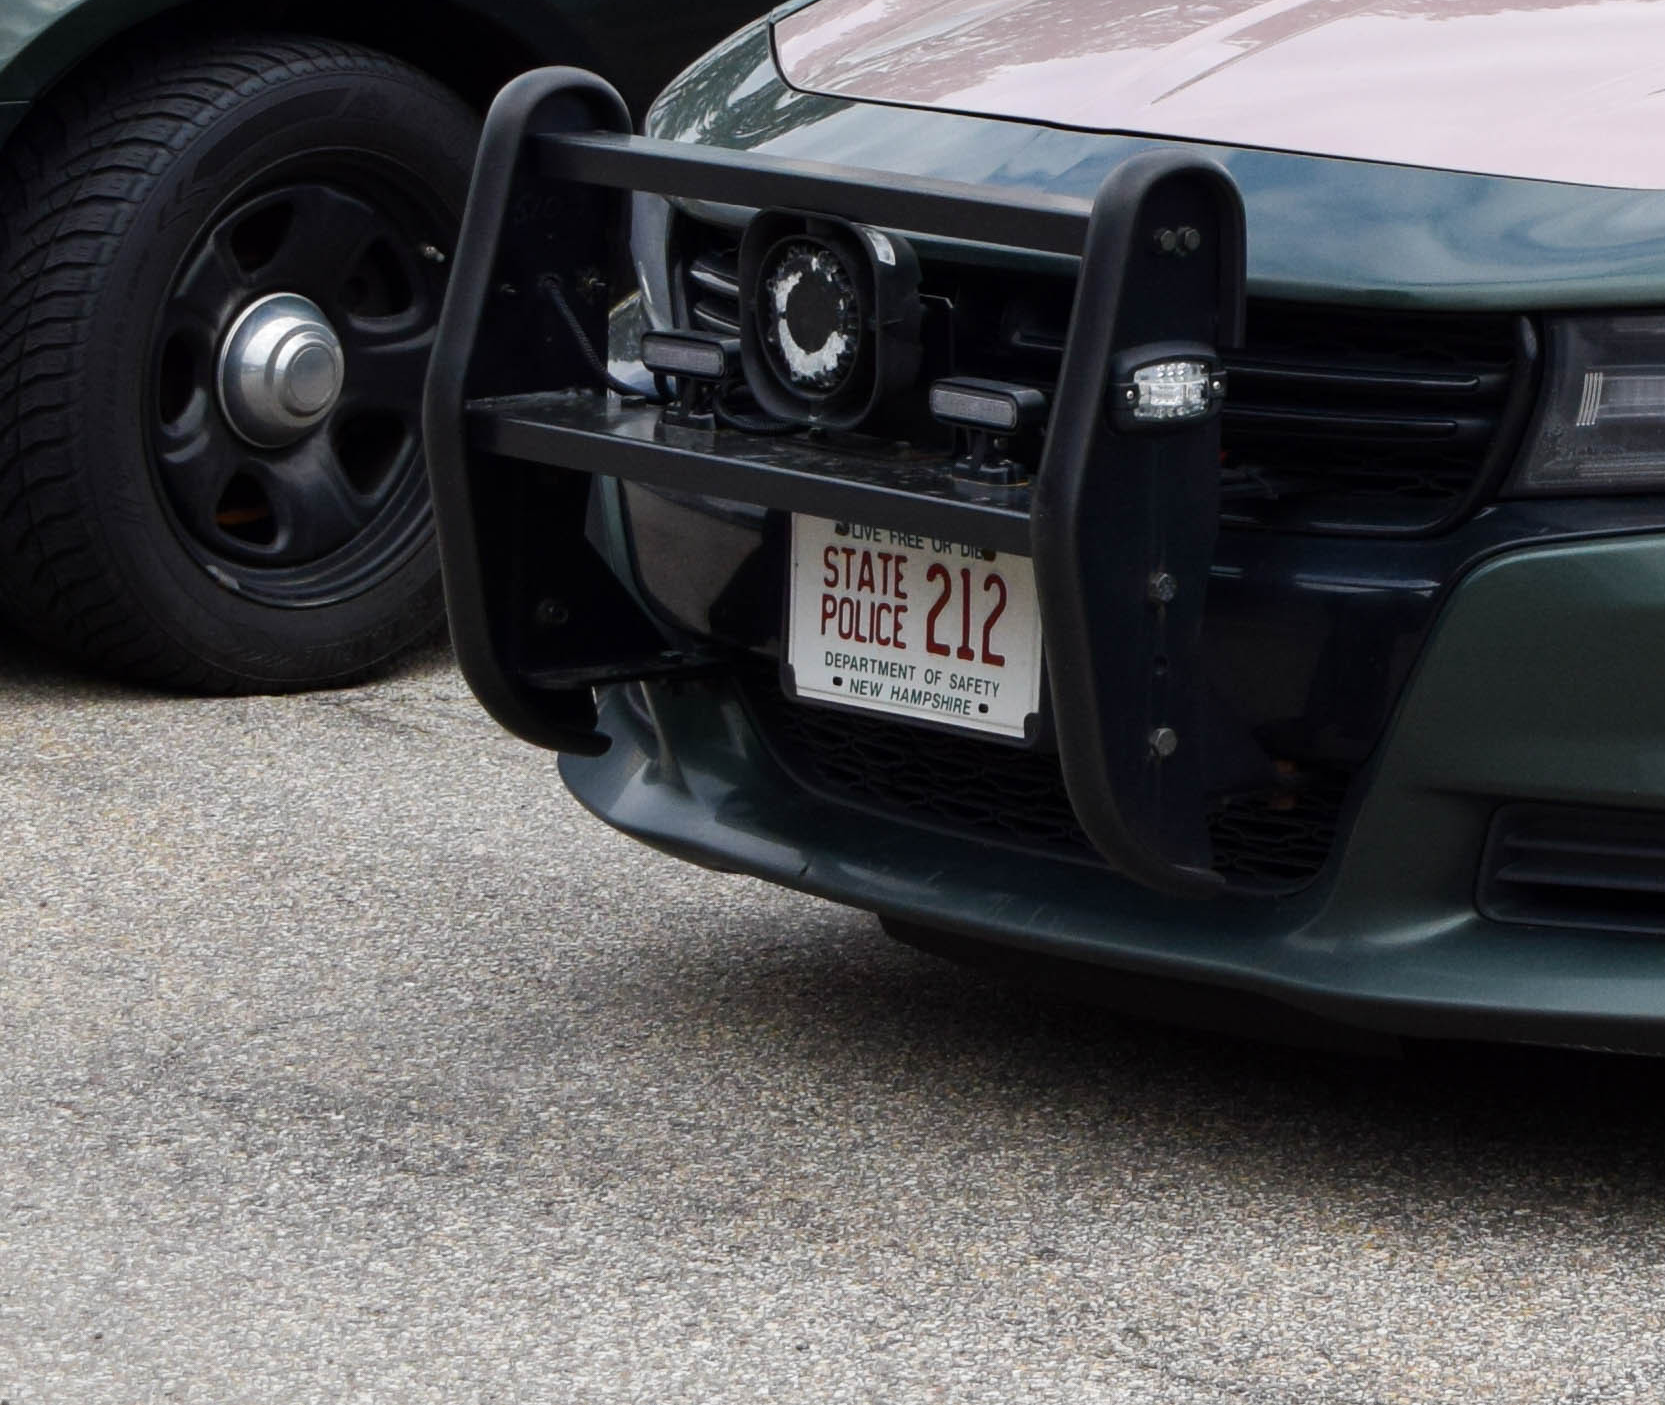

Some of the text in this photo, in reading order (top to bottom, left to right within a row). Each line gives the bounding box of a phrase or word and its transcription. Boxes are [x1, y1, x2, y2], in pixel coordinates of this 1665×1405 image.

[889, 529, 925, 550] FREE
[823, 545, 909, 600] STATE
[820, 593, 909, 650] POLICE
[926, 562, 1008, 668] 212
[824, 650, 1001, 698] DEPARTMENT OF SAFETY
[849, 678, 973, 716] NEW HAMPSHIRE
